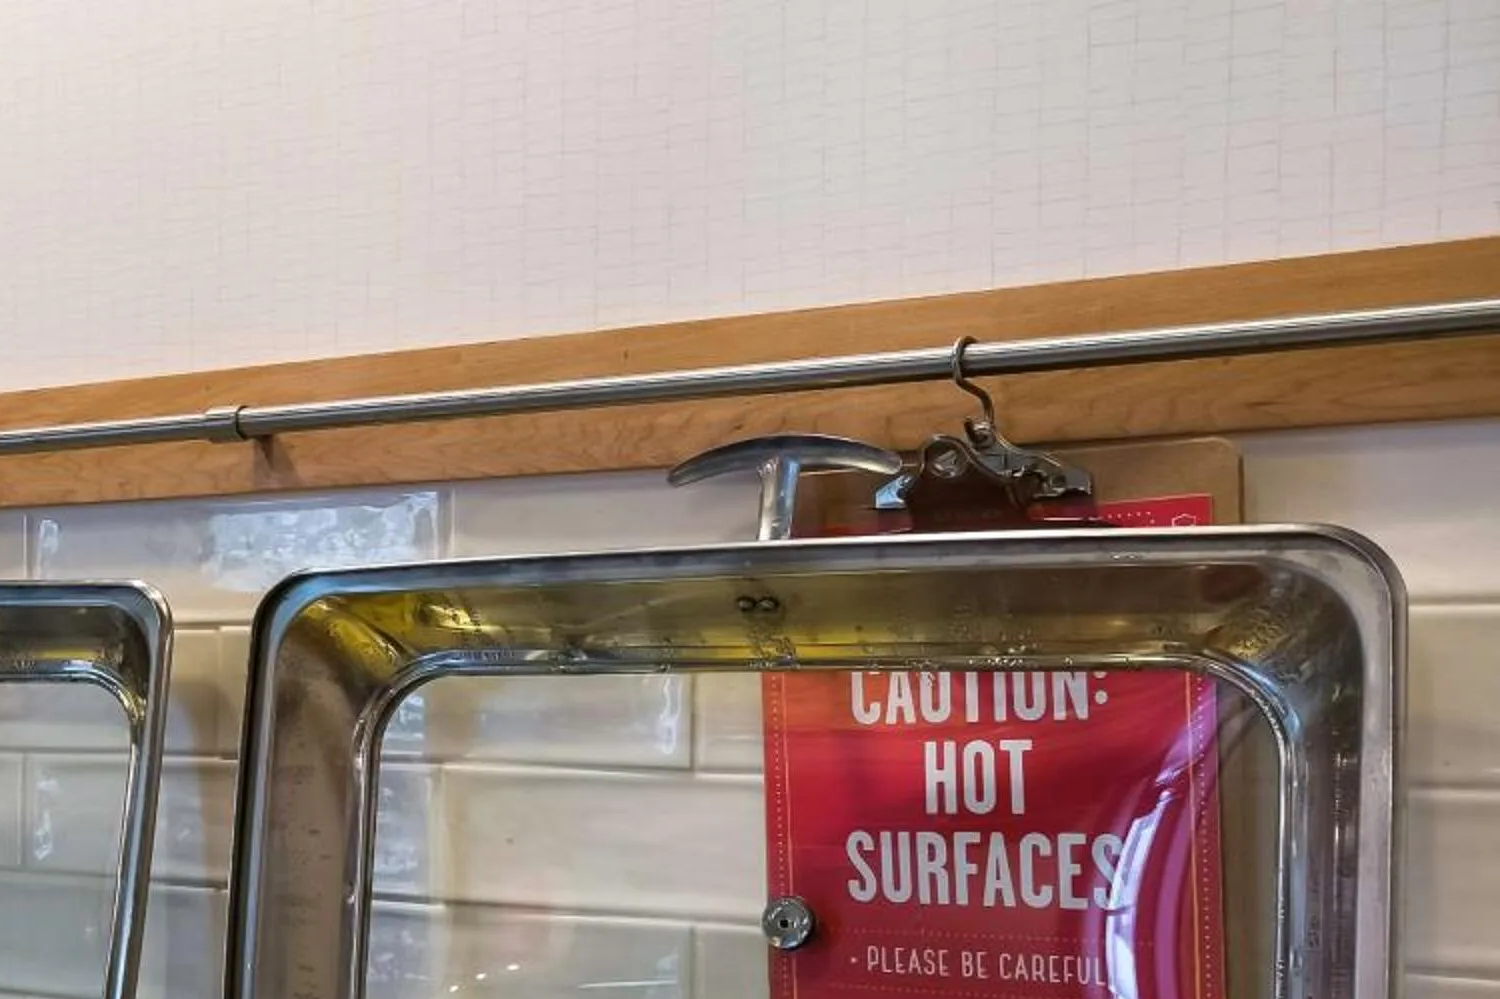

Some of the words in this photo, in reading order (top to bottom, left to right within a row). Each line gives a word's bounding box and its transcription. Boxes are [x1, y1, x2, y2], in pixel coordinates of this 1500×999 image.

[924, 739, 1033, 815] HOT
[846, 830, 1126, 911] SURFACES
[867, 945, 950, 977] PLEASE
[961, 951, 990, 980] BE
[999, 953, 1106, 987] CAREFUL
